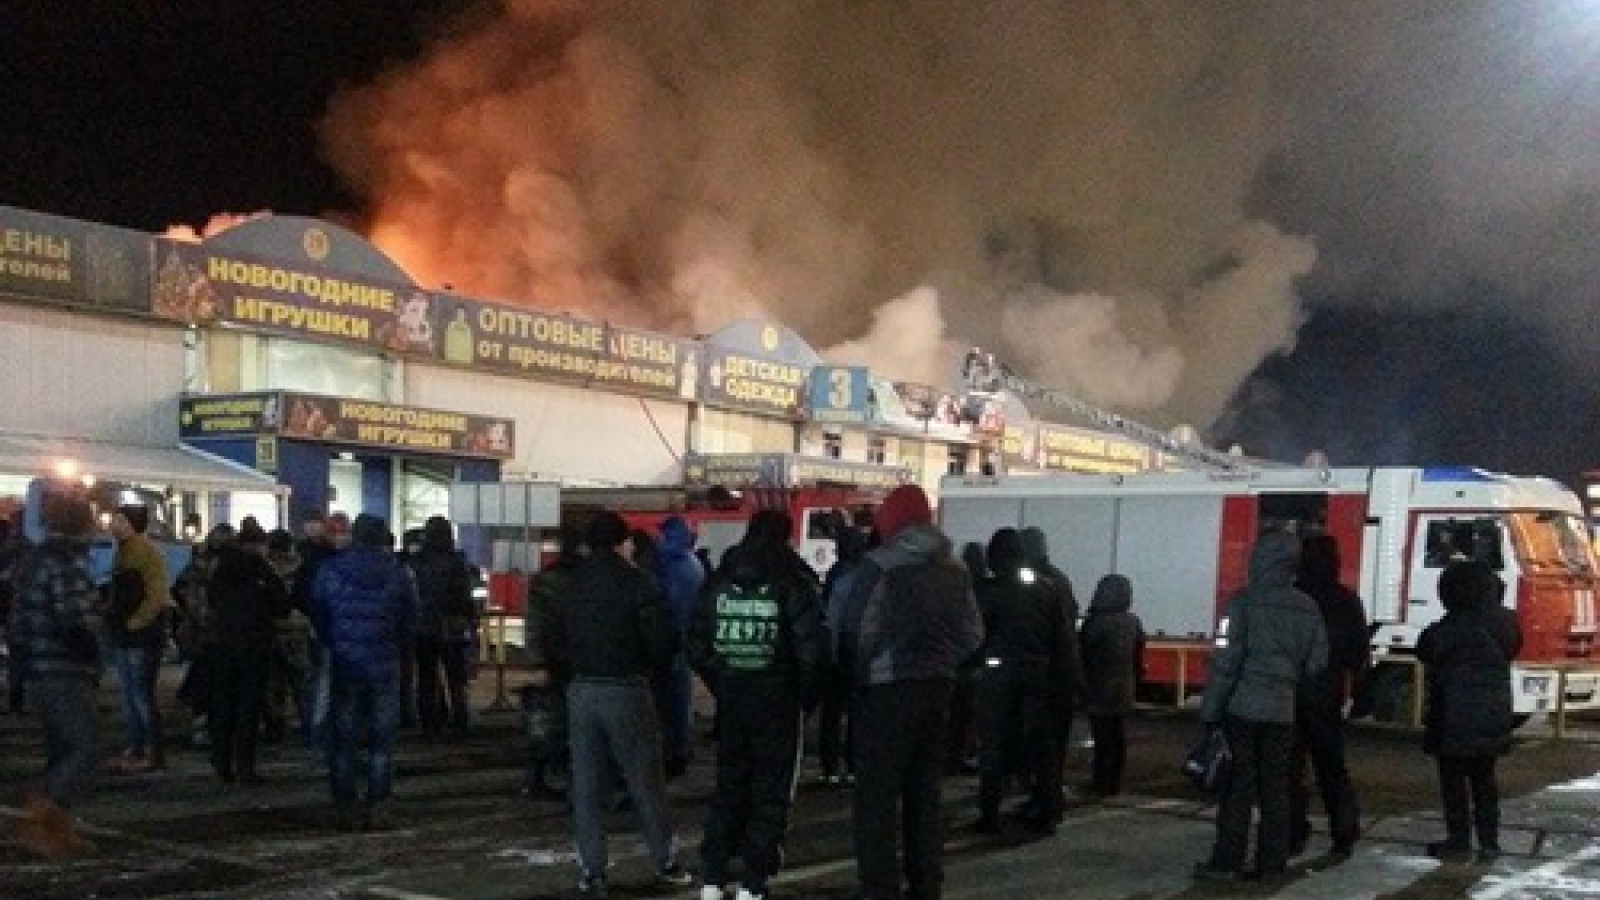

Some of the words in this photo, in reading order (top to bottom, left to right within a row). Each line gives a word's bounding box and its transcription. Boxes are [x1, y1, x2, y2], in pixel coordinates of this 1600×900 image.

[208, 256, 395, 312] НОВОГОДНИЕ
[234, 296, 369, 339] ИГРУШКИ
[479, 307, 603, 352] ОПТОВЫЕ
[477, 339, 503, 358] от
[828, 369, 853, 409] 3
[340, 401, 467, 431] НОВОГОДНИЕ
